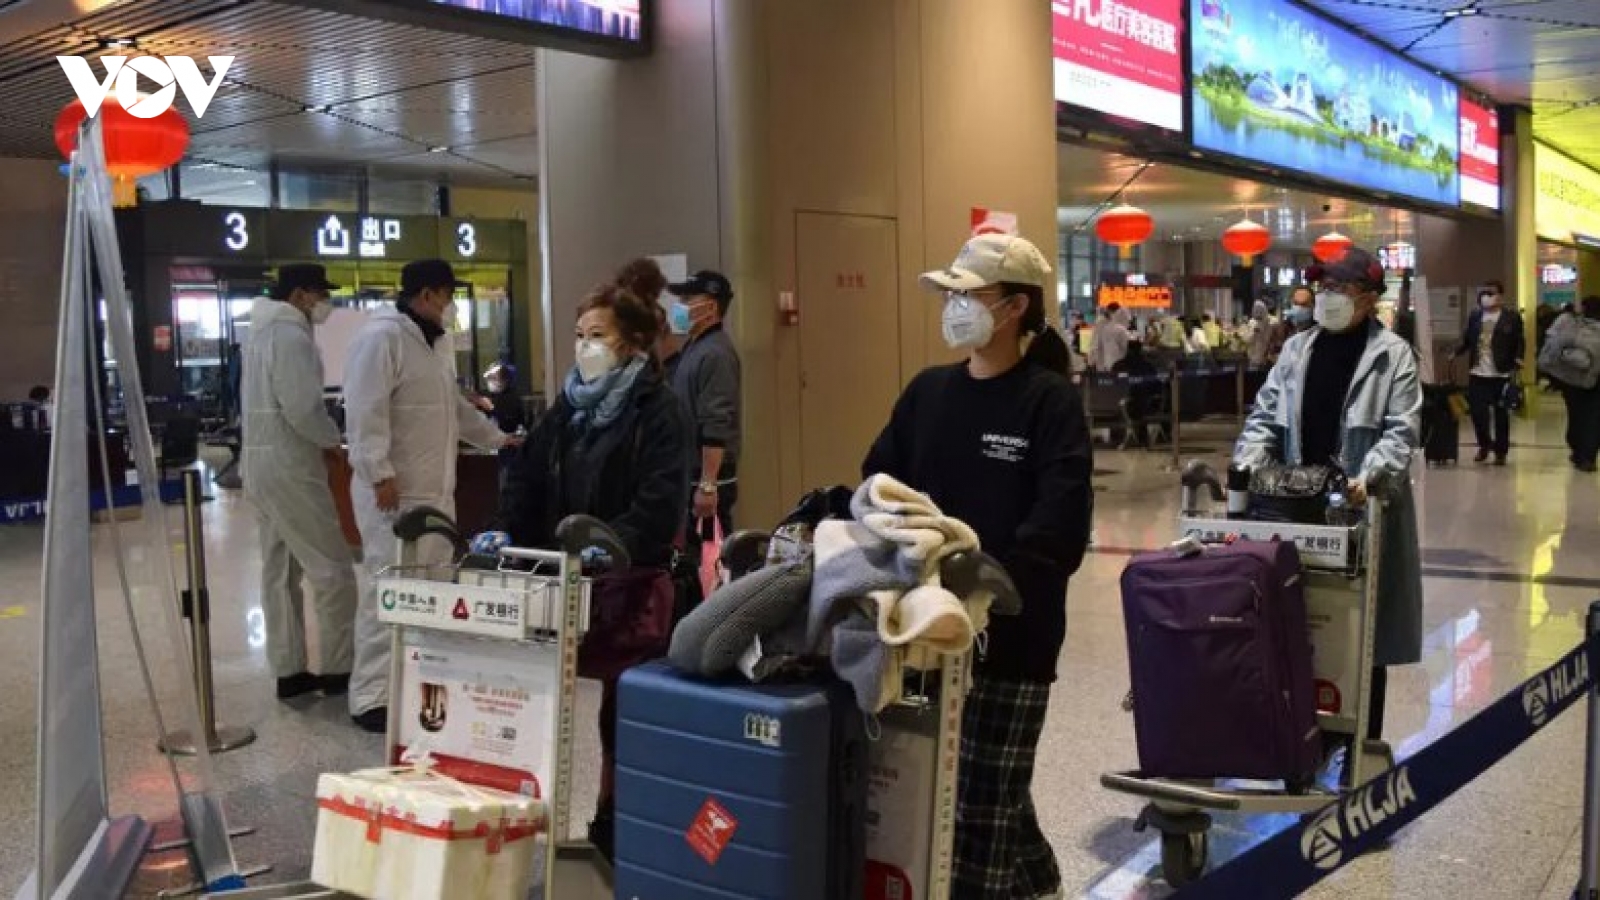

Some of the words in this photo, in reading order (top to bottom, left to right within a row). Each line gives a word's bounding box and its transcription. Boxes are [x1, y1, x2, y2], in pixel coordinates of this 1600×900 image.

[225, 212, 249, 250] 3
[361, 216, 401, 241] 出口
[458, 222, 476, 257] 3
[1550, 651, 1589, 703] HLJA
[1346, 766, 1416, 837] HLJA
